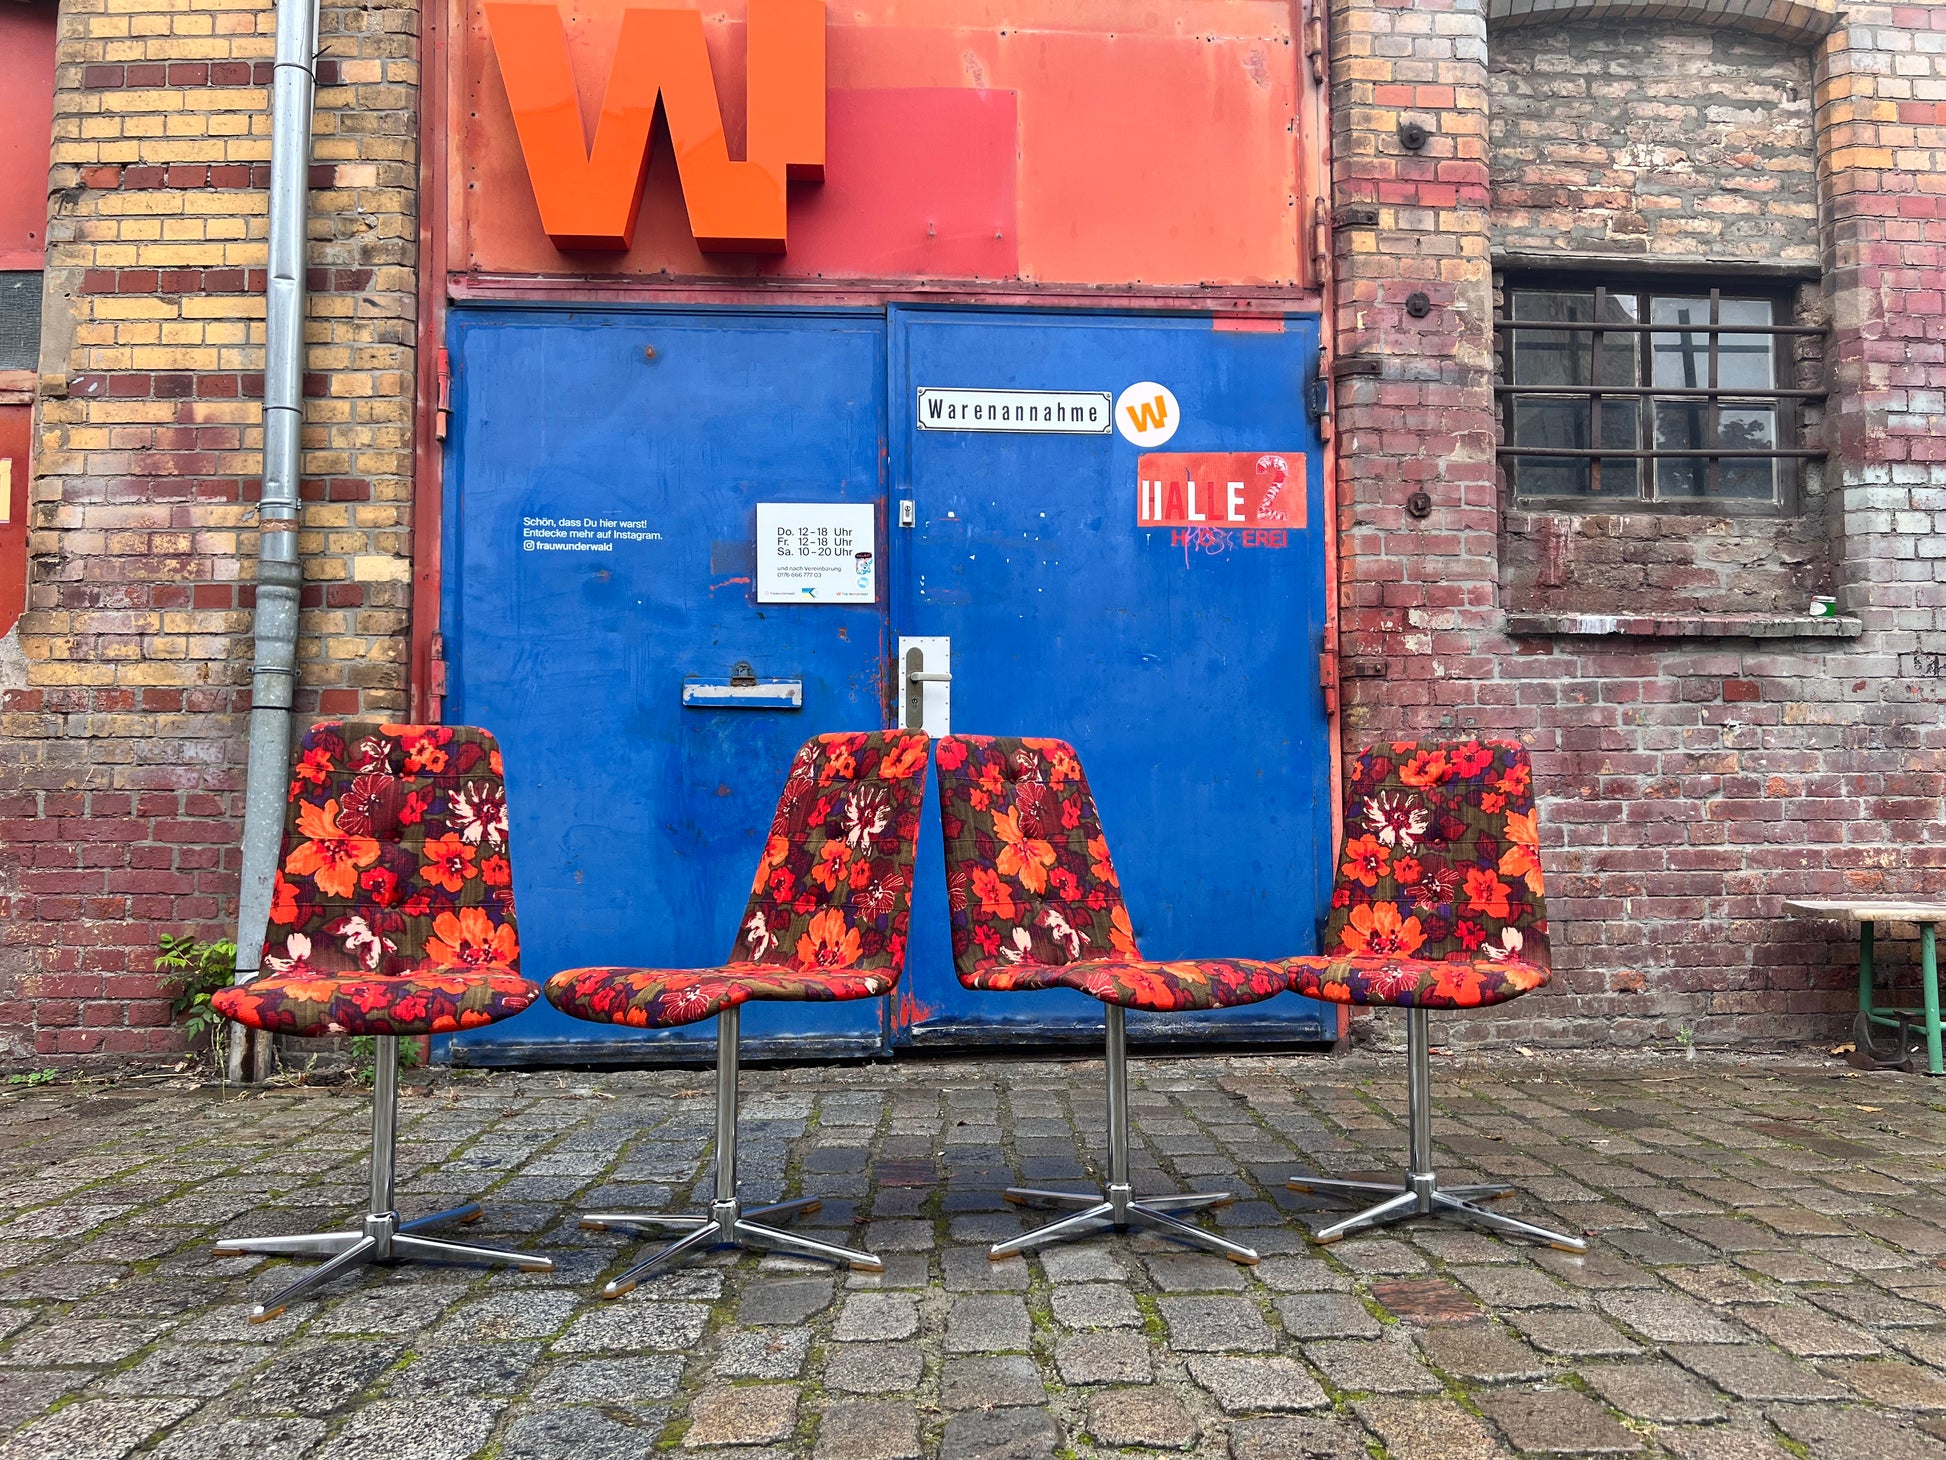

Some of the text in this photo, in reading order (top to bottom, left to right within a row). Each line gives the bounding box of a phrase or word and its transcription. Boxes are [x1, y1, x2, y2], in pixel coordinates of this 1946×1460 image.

[927, 398, 1099, 423] Warenannahme
[1141, 455, 1289, 522] HALLE 2
[523, 516, 647, 529] Schön, dass Du hier warst!
[523, 528, 663, 541] Entdecke mehr auf Instagram.
[777, 527, 794, 536] Do.
[834, 527, 853, 537] Uhr
[536, 541, 613, 551] frauwunderwald
[777, 537, 789, 546] Fr.
[834, 537, 853, 547] Uhr
[777, 547, 794, 556] Sa.
[834, 547, 853, 557] Uhr
